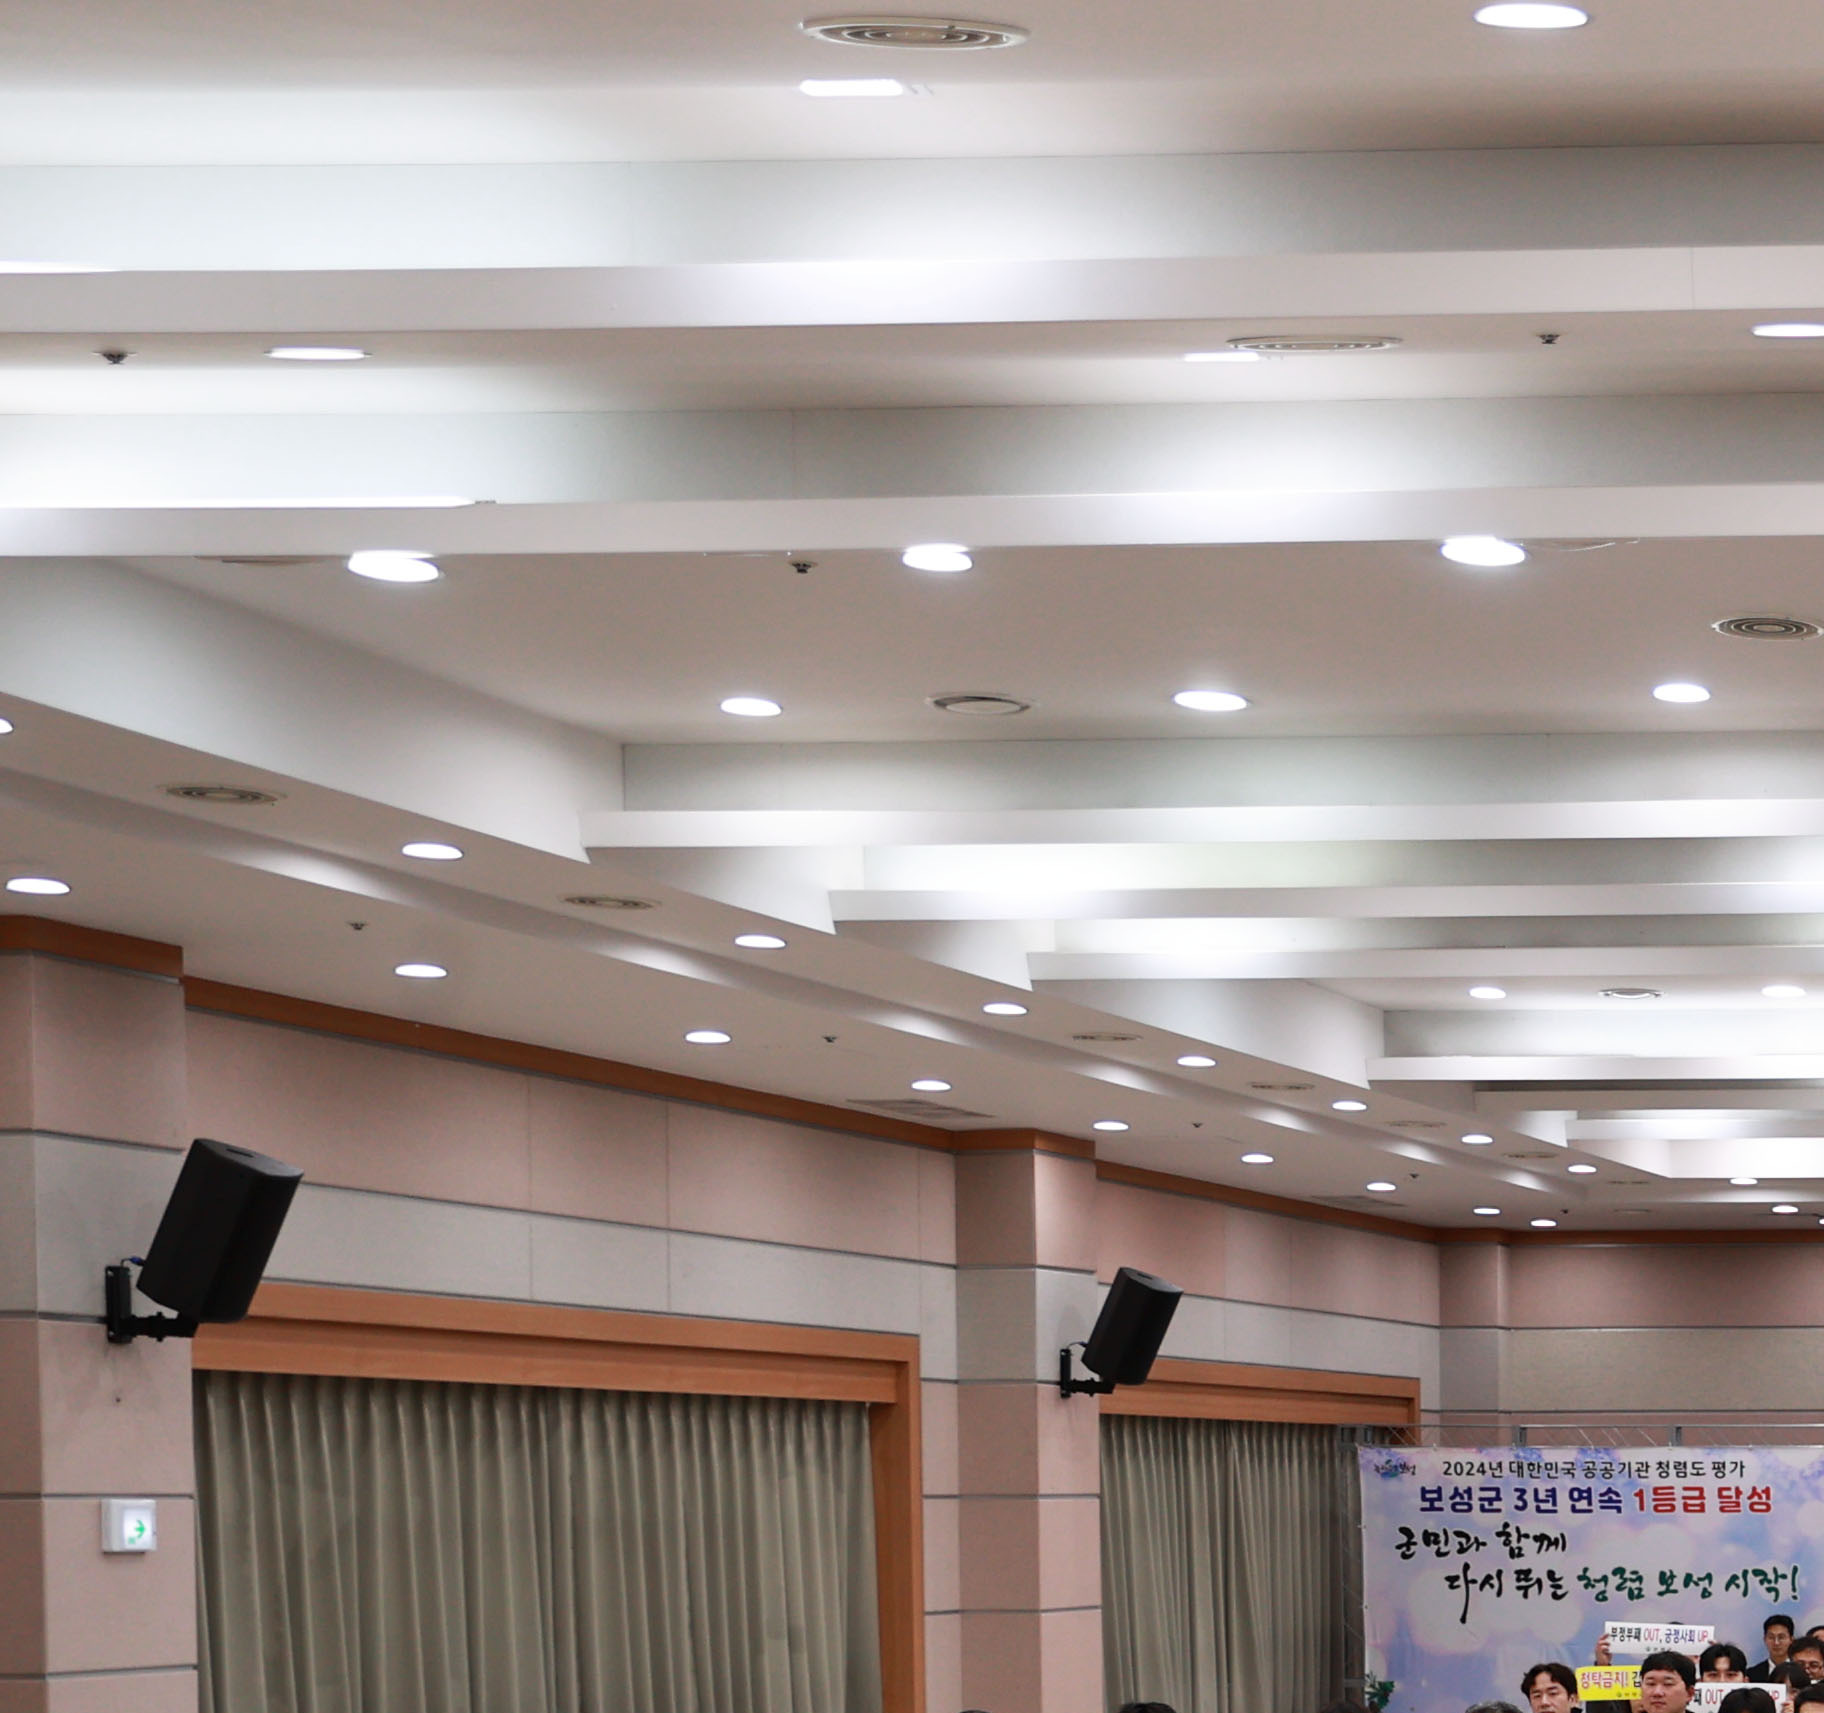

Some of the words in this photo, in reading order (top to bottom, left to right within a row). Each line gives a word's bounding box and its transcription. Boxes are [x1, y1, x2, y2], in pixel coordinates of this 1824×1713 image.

[1442, 1461, 1504, 1480] 2024년
[1510, 1460, 1577, 1480] 대한민국
[1582, 1461, 1651, 1480] 공공기관
[1656, 1461, 1705, 1479] 청렴도
[1711, 1460, 1747, 1479] 평가
[1419, 1486, 1503, 1514] 보성군
[1513, 1486, 1559, 1514] 3년
[1568, 1486, 1623, 1514] 연속
[1633, 1485, 1706, 1514] 1등급
[1717, 1485, 1773, 1514] 달성
[1395, 1525, 1487, 1560] 군민과
[1495, 1521, 1567, 1559] 함께
[1444, 1562, 1504, 1625] 다시
[1514, 1568, 1569, 1602] 뛰는
[1577, 1565, 1645, 1602] 청렴
[1657, 1568, 1713, 1602] 보성
[1724, 1564, 1800, 1602] 시작!
